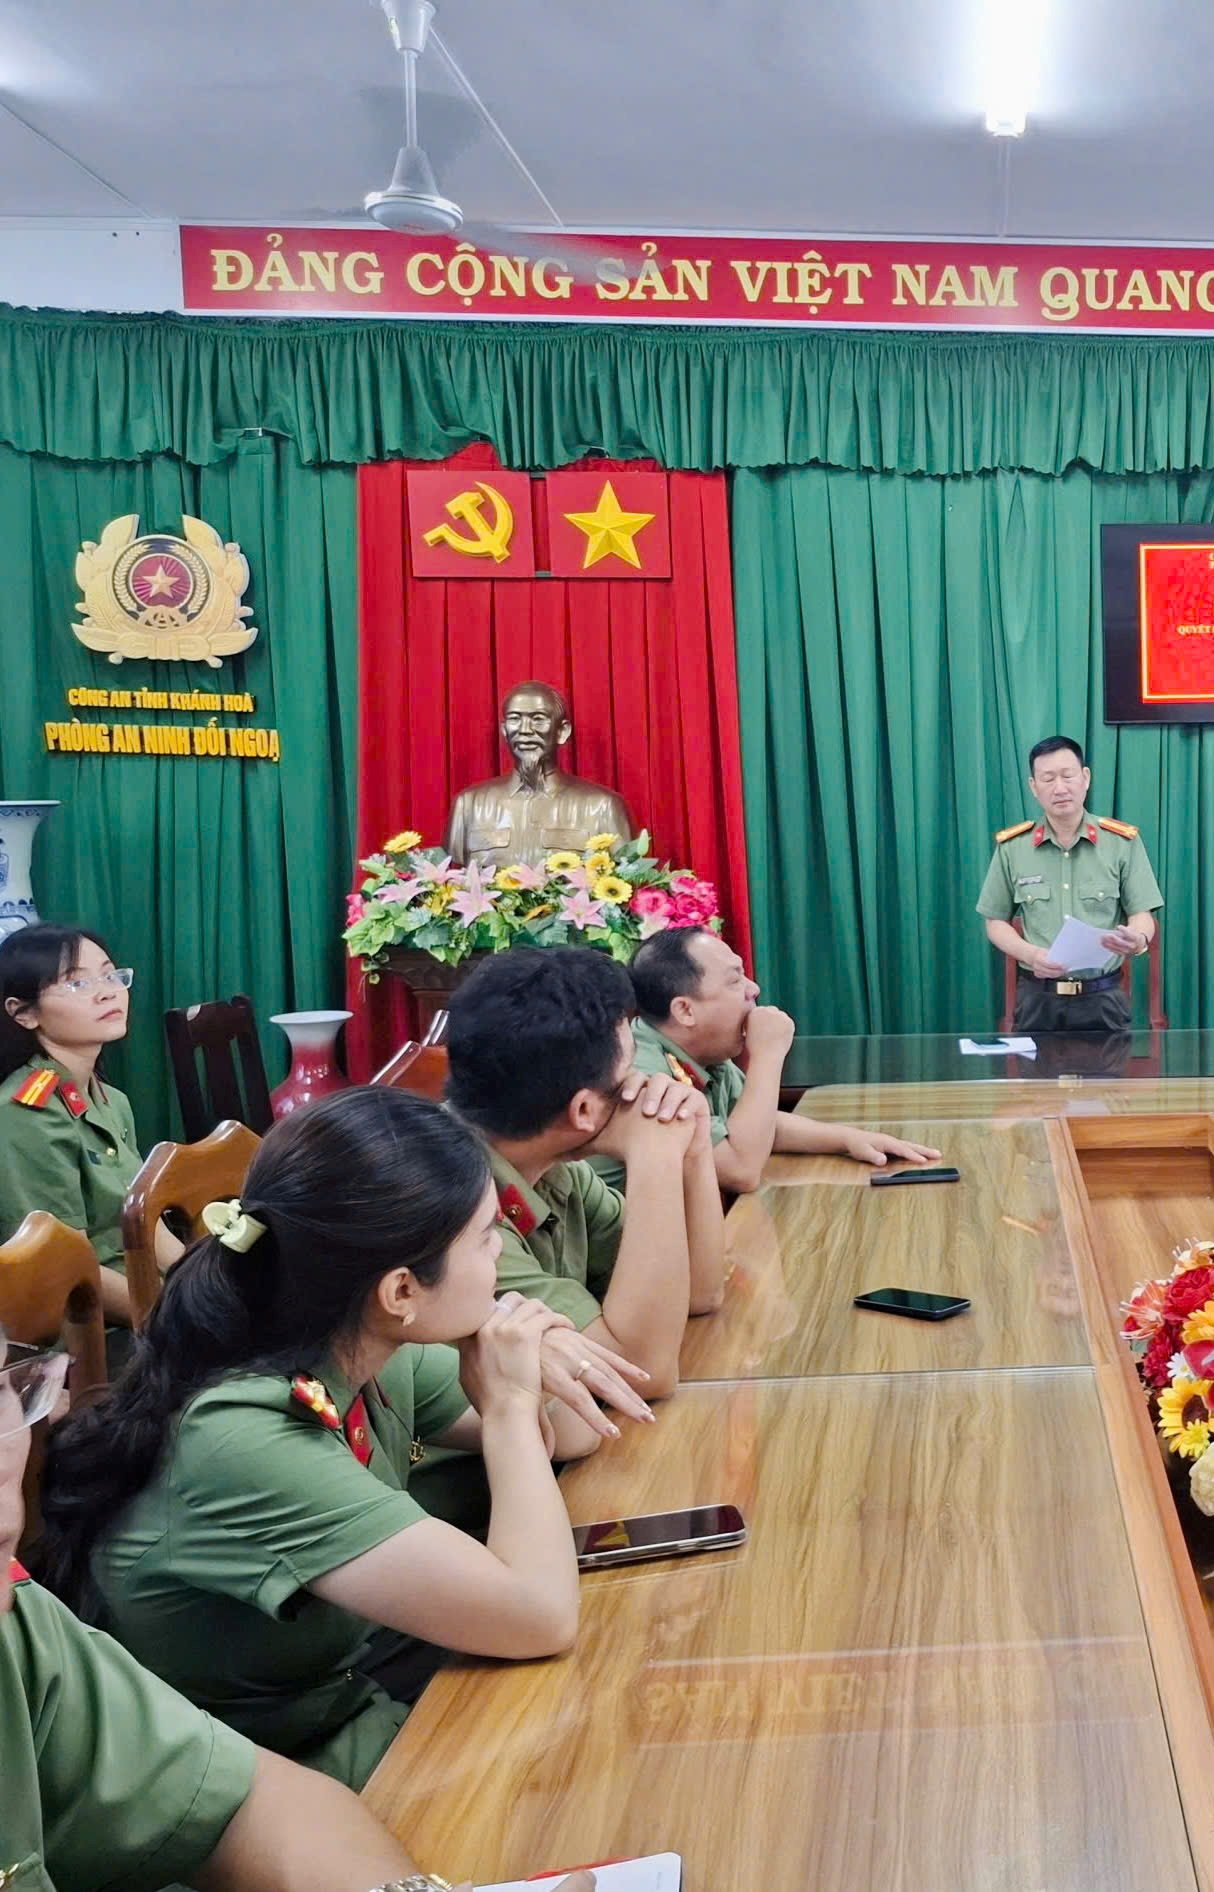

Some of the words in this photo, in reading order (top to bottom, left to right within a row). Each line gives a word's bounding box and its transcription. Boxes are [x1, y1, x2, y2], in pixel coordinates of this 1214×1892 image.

[211, 234, 384, 294] ĐẢNG
[407, 243, 573, 305] CỘNG
[594, 243, 711, 300] SẢN
[731, 251, 871, 314] VIỆT
[892, 264, 1018, 307] NAM
[68, 687, 109, 706] CÔNG
[110, 691, 132, 708] AN
[170, 689, 221, 711] KHÁNH
[45, 718, 110, 753] PHÒNG
[113, 725, 142, 754] AN
[143, 726, 191, 756] NINH
[193, 716, 227, 756] ĐỐI
